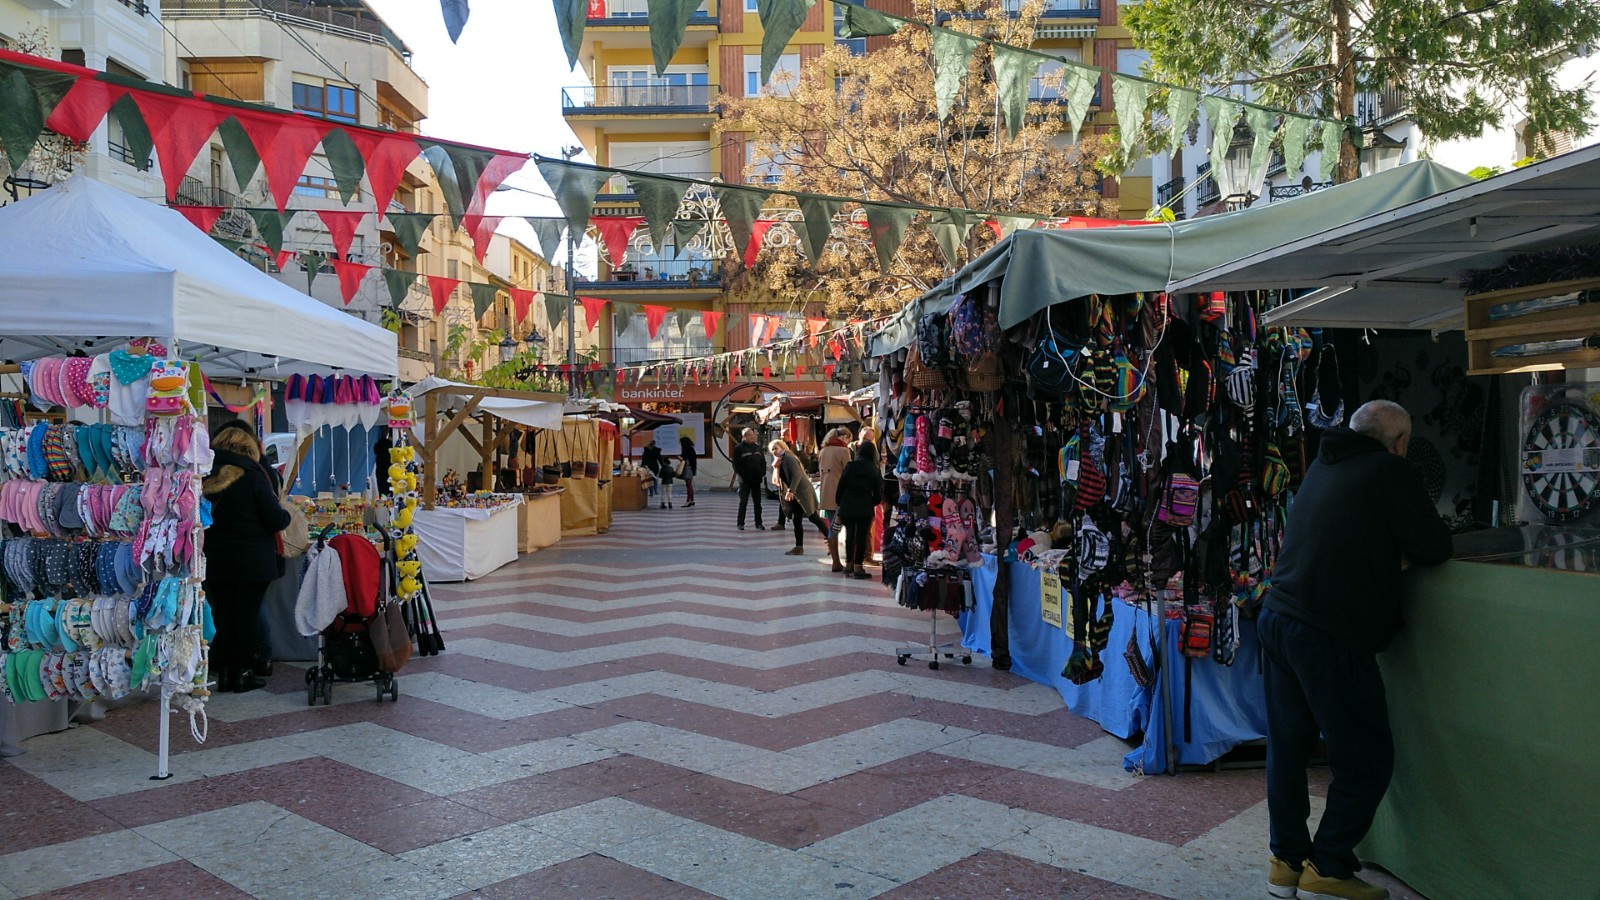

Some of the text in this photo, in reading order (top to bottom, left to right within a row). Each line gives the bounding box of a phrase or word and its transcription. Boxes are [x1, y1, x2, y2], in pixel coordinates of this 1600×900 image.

[1548, 510, 1555, 518] 19
[1560, 513, 1566, 521] 3
[1573, 510, 1580, 518] 17
